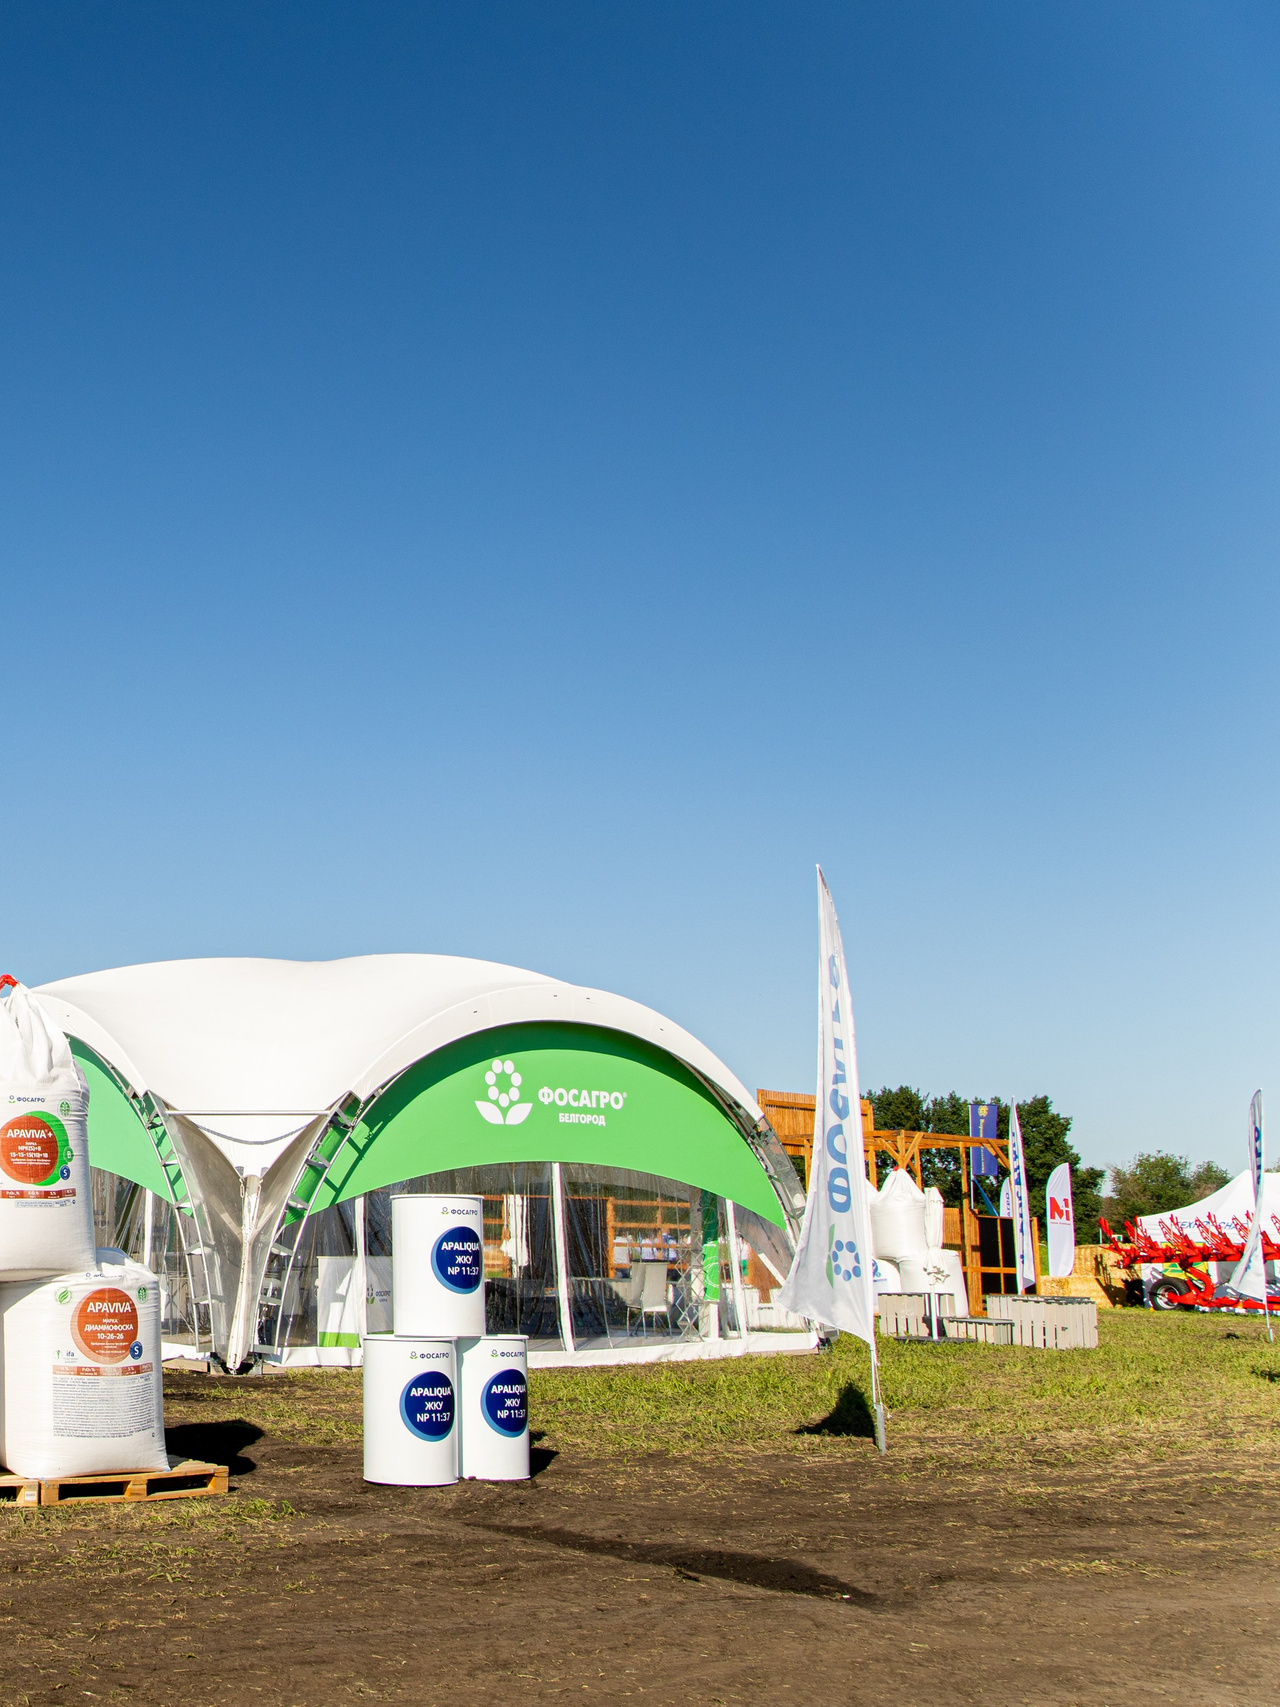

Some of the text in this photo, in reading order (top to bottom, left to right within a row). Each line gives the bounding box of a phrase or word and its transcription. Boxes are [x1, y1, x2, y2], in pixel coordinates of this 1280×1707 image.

[538, 1086, 624, 1110] ФОСАГРО
[559, 1112, 606, 1126] БЕЛГОРОД
[63, 1169, 68, 1177] S
[441, 1241, 479, 1252] APALIQUA
[455, 1255, 473, 1264] ЖКУ
[447, 1266, 479, 1275] NP 11:37
[87, 1302, 131, 1313] APAVIVA
[84, 1324, 134, 1332] ДИАММОФОСКА
[134, 1345, 139, 1355] S
[410, 1387, 451, 1398] APALIQUA
[491, 1384, 526, 1395] APALIQUA
[425, 1401, 444, 1410] ЖКУ
[505, 1398, 521, 1407] ЖКУ
[416, 1412, 451, 1422] NP 11:37
[497, 1409, 526, 1418] NP 11:37
